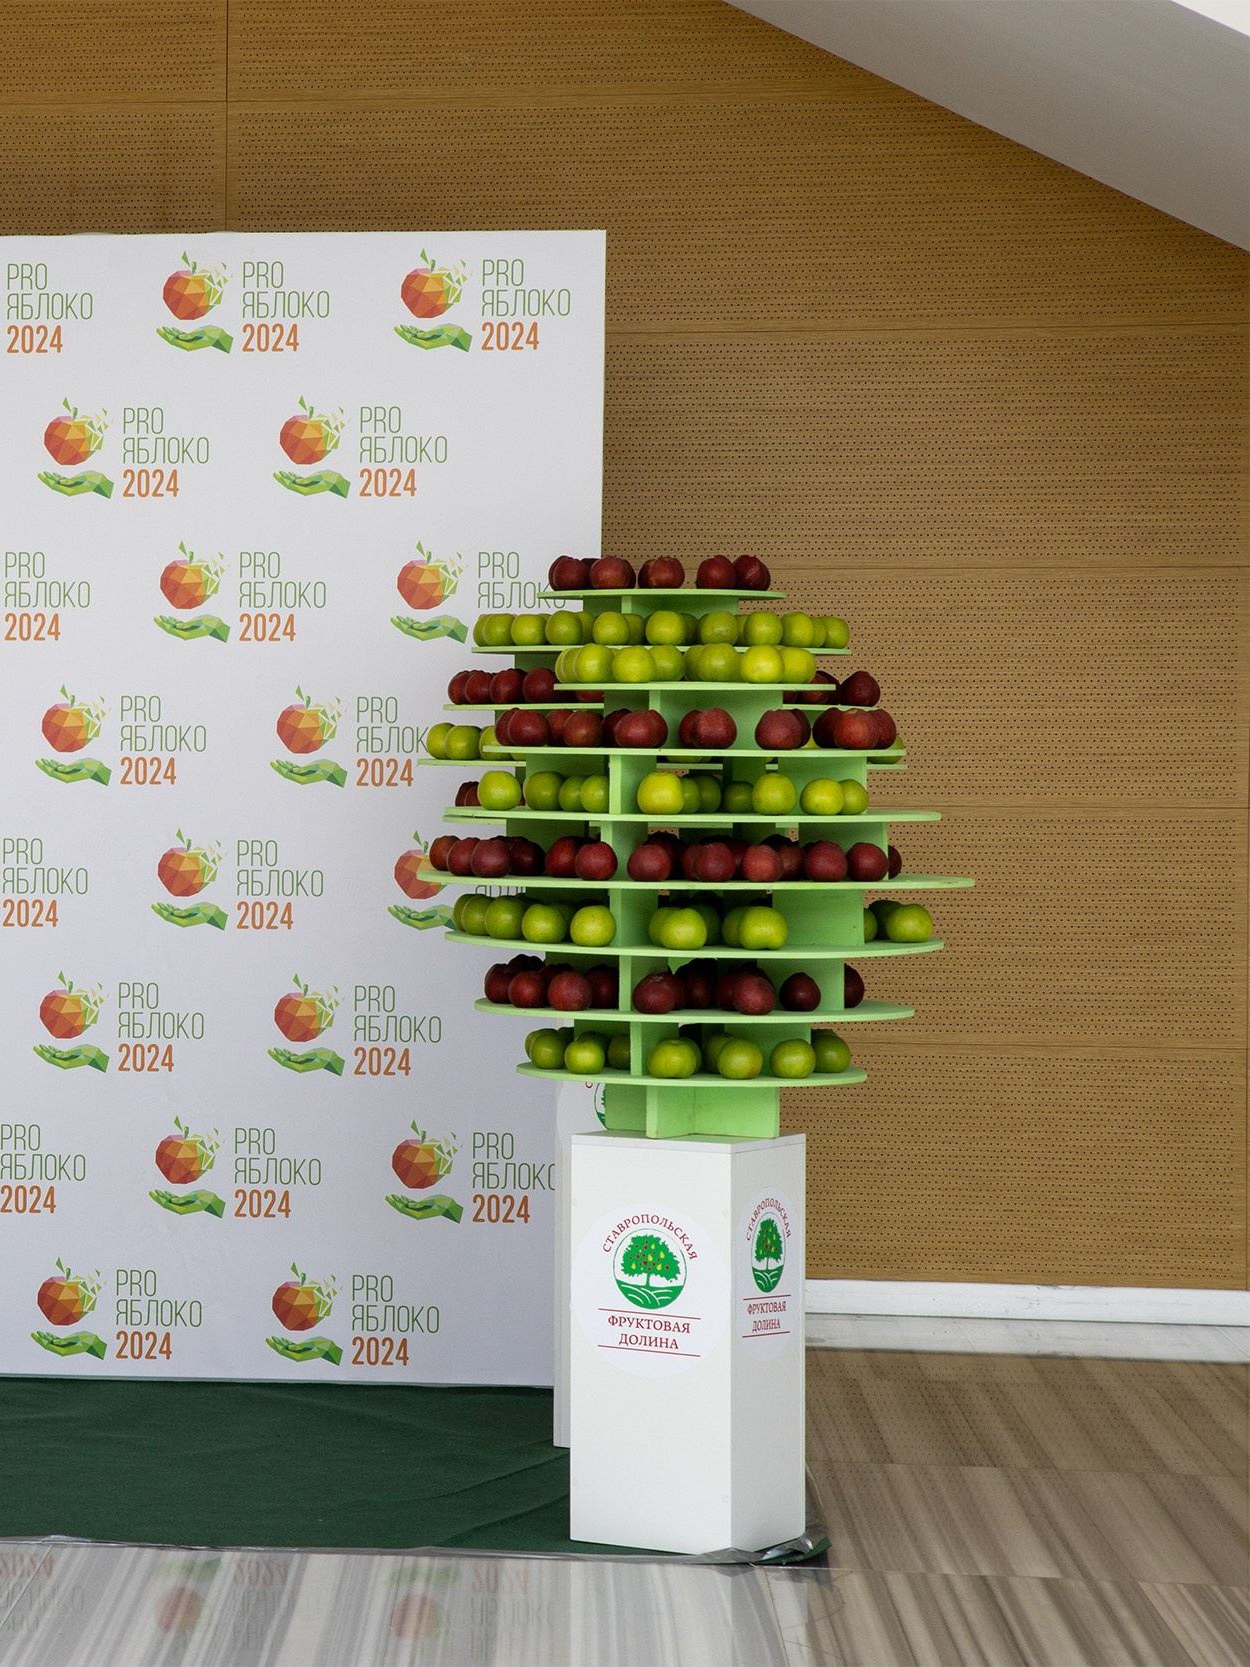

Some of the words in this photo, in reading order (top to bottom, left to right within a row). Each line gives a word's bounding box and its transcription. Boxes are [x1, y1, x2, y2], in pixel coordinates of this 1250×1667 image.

[6, 262, 48, 291] PRO
[242, 260, 284, 289] PRO
[481, 258, 525, 287] PRO
[6, 292, 93, 321] ЯБЛОКО
[242, 290, 330, 319] ЯБЛОКО
[481, 288, 571, 317] ЯБЛОКО
[6, 324, 64, 355] 2024
[241, 322, 300, 353] 2024
[480, 321, 540, 352] 2024
[122, 407, 164, 435] PRO
[359, 405, 402, 434] PRO
[122, 436, 210, 465] ЯБЛОКО
[359, 435, 448, 464] ЯБЛОКО
[122, 468, 180, 499] 2024
[358, 467, 418, 498] 2024
[4, 551, 46, 579] PRO
[239, 551, 281, 579] PRO
[477, 551, 521, 579] PRO
[4, 580, 91, 609] ЯБЛОКО
[239, 580, 327, 609] ЯБЛОКО
[4, 612, 61, 642] 2024
[238, 612, 297, 643] 2024
[120, 695, 162, 723] PRO
[356, 696, 399, 724] PRO
[120, 724, 207, 753] ЯБЛОКО
[356, 725, 430, 754] ЯБЛОК
[119, 755, 177, 786] 2024
[355, 757, 415, 788] 2024
[2, 837, 43, 866] PRO
[236, 839, 278, 868] PRO
[2, 867, 89, 895] ЯБЛОКО
[236, 869, 324, 898] ЯБЛОКО
[2, 898, 59, 928] 2024
[236, 900, 294, 931] 2024
[118, 982, 159, 1010] PRO
[354, 985, 396, 1013] PRO
[117, 1011, 205, 1040] ЯБЛОКО
[353, 1014, 442, 1044] ЯБЛОКО
[117, 1042, 175, 1073] 2024
[353, 1046, 412, 1077] 2024
[0, 1123, 41, 1152] PRO
[234, 1127, 276, 1156] PRO
[472, 1131, 515, 1161] PRO
[0, 1153, 87, 1182] ЯБЛОКО
[234, 1157, 322, 1186] ЯБЛОКО
[0, 1184, 57, 1215] 2024
[233, 1188, 292, 1219] 2024
[471, 1193, 531, 1225] 2024
[746, 1197, 791, 1242] СТАВРОПОЛЬСКАЯ
[602, 1213, 698, 1261] СТАВРОПОЛЬСКАЯ
[115, 1268, 157, 1298] PRO
[352, 1274, 394, 1303] PRO
[115, 1298, 203, 1328] ЯБЛОКО
[351, 1304, 440, 1334] ЯБЛОКО
[747, 1301, 787, 1316] ФРУКТОВАЯ
[607, 1315, 691, 1334] ФРУКТОВАЯ
[752, 1318, 781, 1333] ДОЛИНА
[115, 1329, 173, 1361] 2024
[351, 1335, 410, 1367] 2024
[618, 1333, 679, 1350] ДОЛИНА
